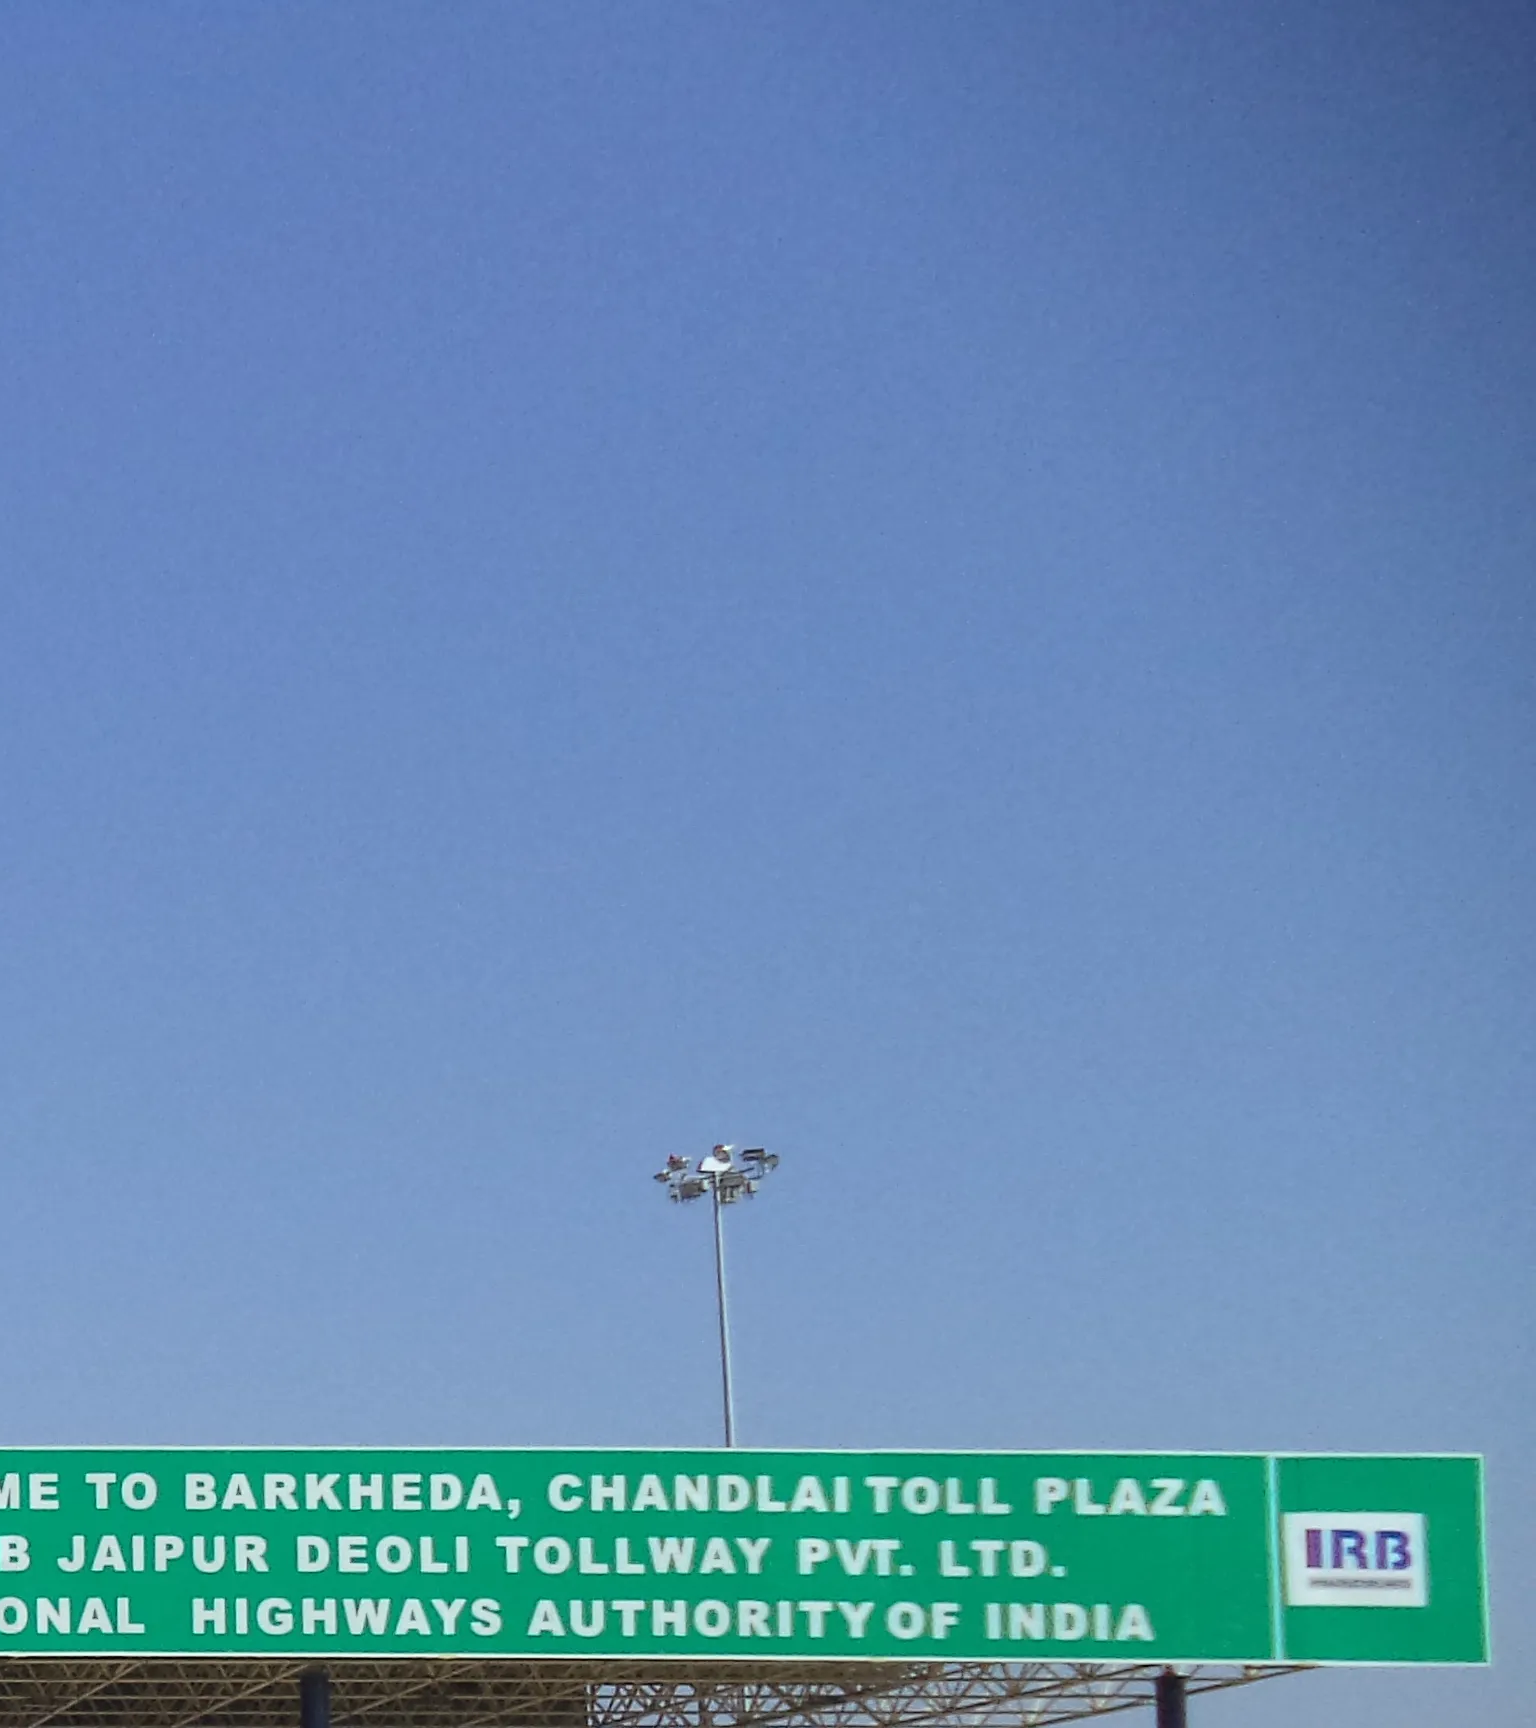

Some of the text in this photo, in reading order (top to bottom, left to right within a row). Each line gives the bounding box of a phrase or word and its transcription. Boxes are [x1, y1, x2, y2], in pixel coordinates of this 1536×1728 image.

[85, 1472, 157, 1510] TO
[185, 1473, 520, 1519] BARKHEDA,
[549, 1474, 848, 1512] CHANDLAI
[869, 1476, 1010, 1514] TOLL
[1037, 1477, 1225, 1516] PLAZA
[57, 1535, 269, 1573] JAIPUR
[297, 1535, 468, 1573] DEOLI
[496, 1536, 769, 1574] TOLLWAY
[799, 1538, 912, 1575] PVT.
[941, 1540, 1064, 1577] LTD.
[1305, 1529, 1412, 1570] IRB
[193, 1597, 502, 1636] HIGHWAYS
[528, 1600, 874, 1638] AUTHORITY
[888, 1602, 959, 1639] OF
[987, 1603, 1153, 1641] INDIA
